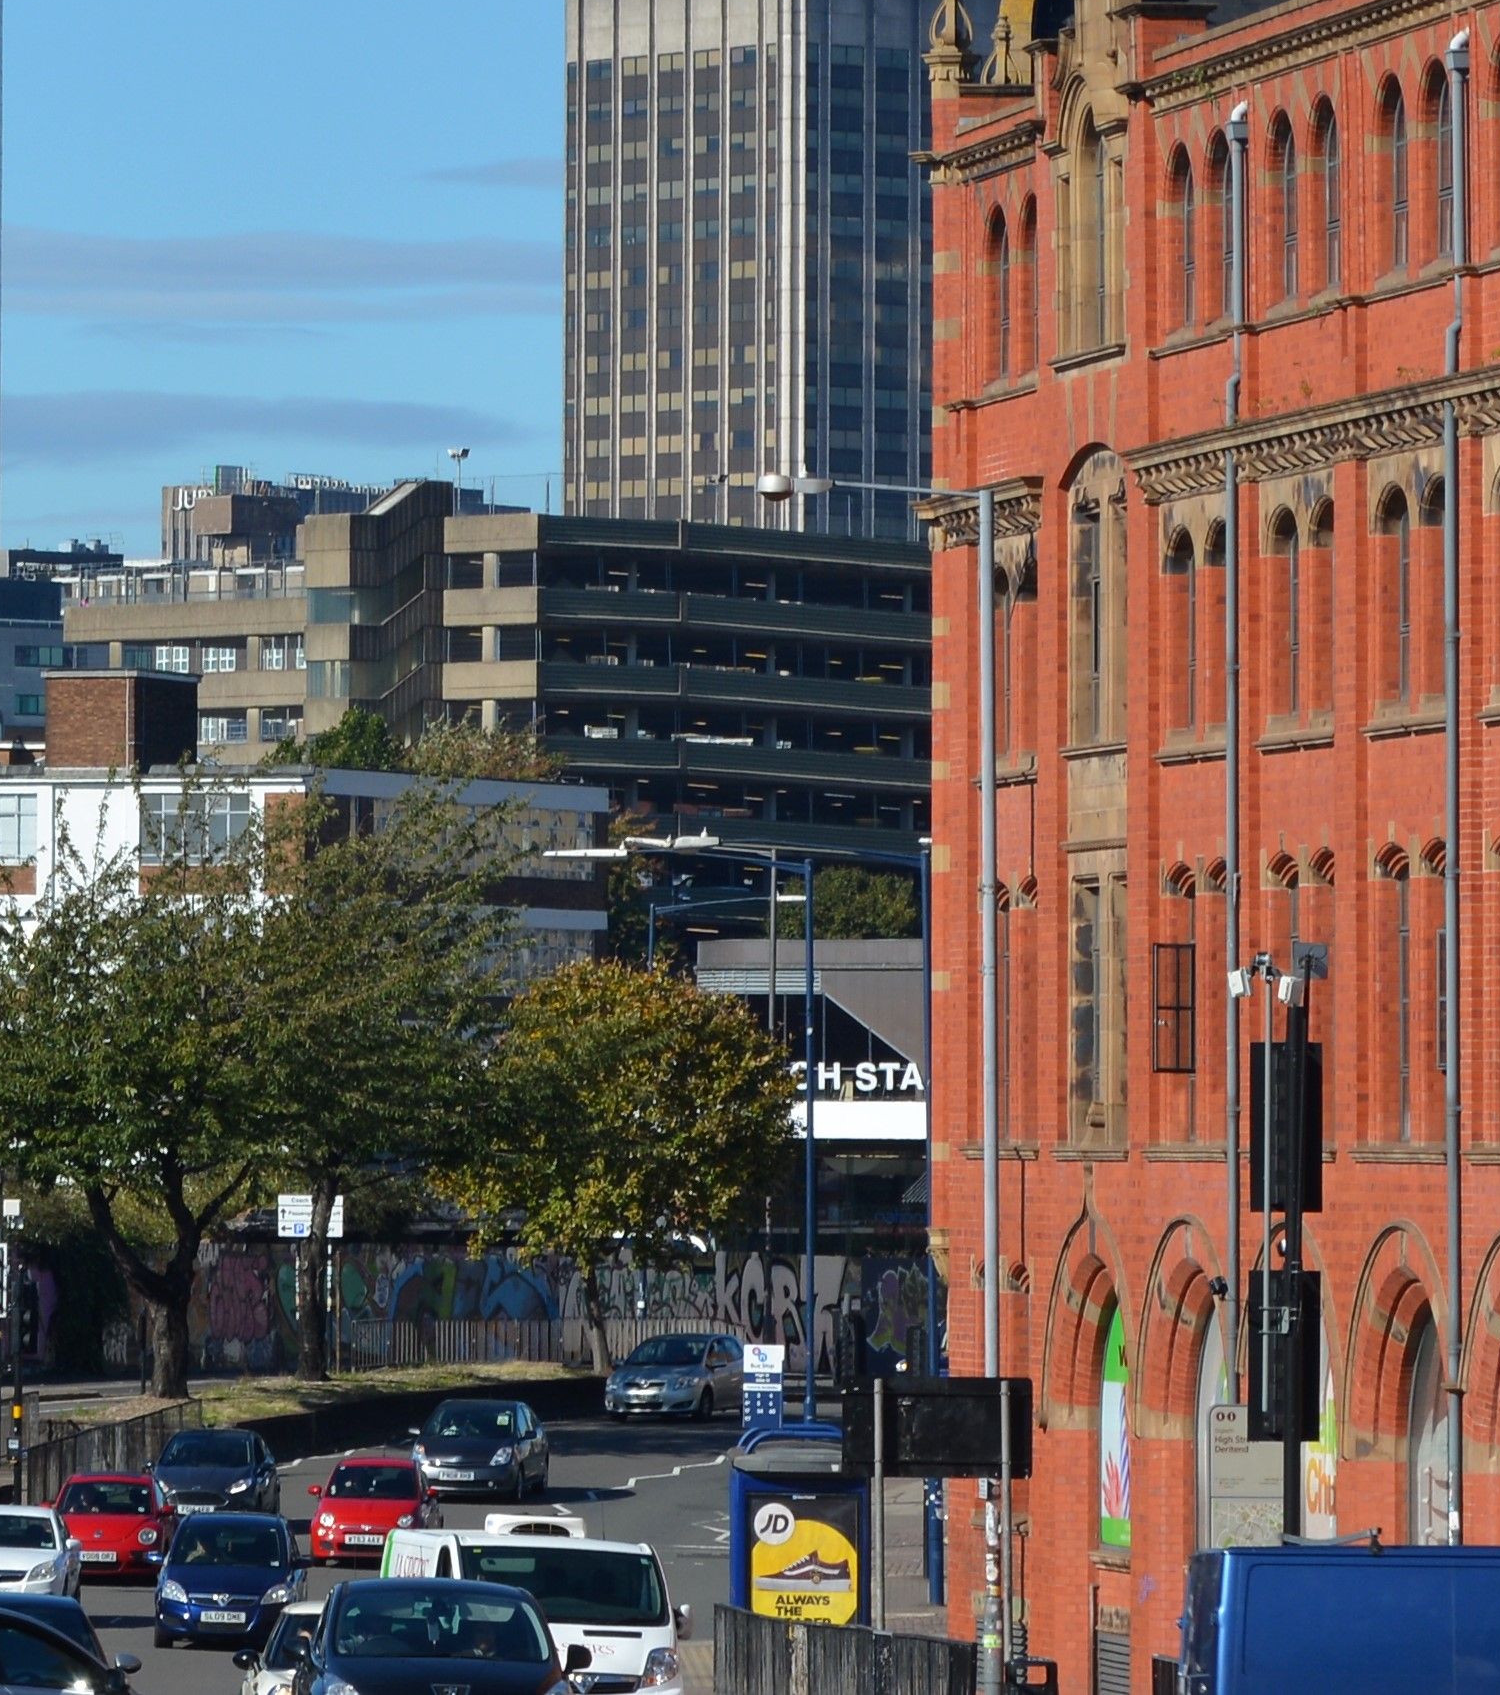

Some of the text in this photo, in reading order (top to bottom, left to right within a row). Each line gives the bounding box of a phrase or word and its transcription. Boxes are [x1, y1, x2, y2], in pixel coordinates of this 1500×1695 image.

[1215, 1435, 1233, 1445] High
[1215, 1445, 1249, 1454] Deritend
[760, 1513, 790, 1534] JD
[775, 1594, 831, 1606] ALWAYS
[776, 1606, 803, 1617] THE
